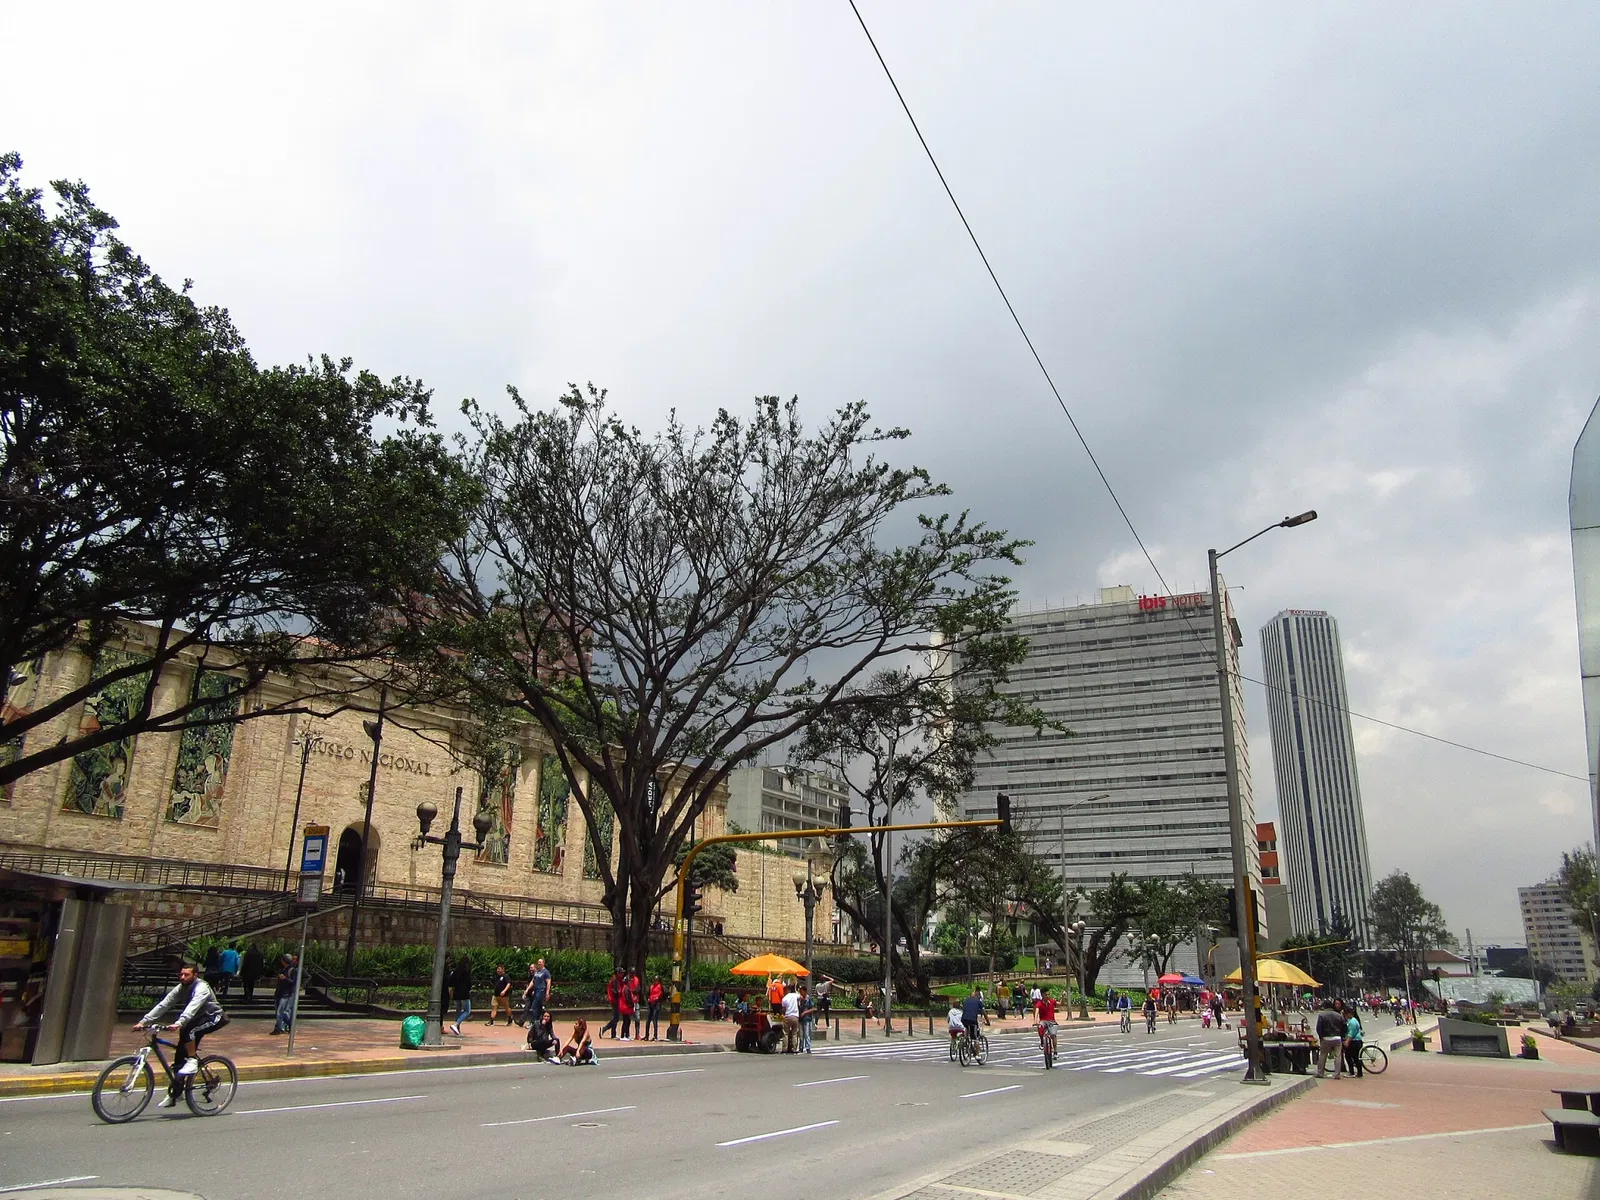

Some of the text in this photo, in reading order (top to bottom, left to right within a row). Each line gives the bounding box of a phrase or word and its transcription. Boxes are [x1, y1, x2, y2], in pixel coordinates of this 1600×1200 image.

[1138, 593, 1206, 610] ibis HOTEL
[360, 749, 431, 776] NCIONAL
